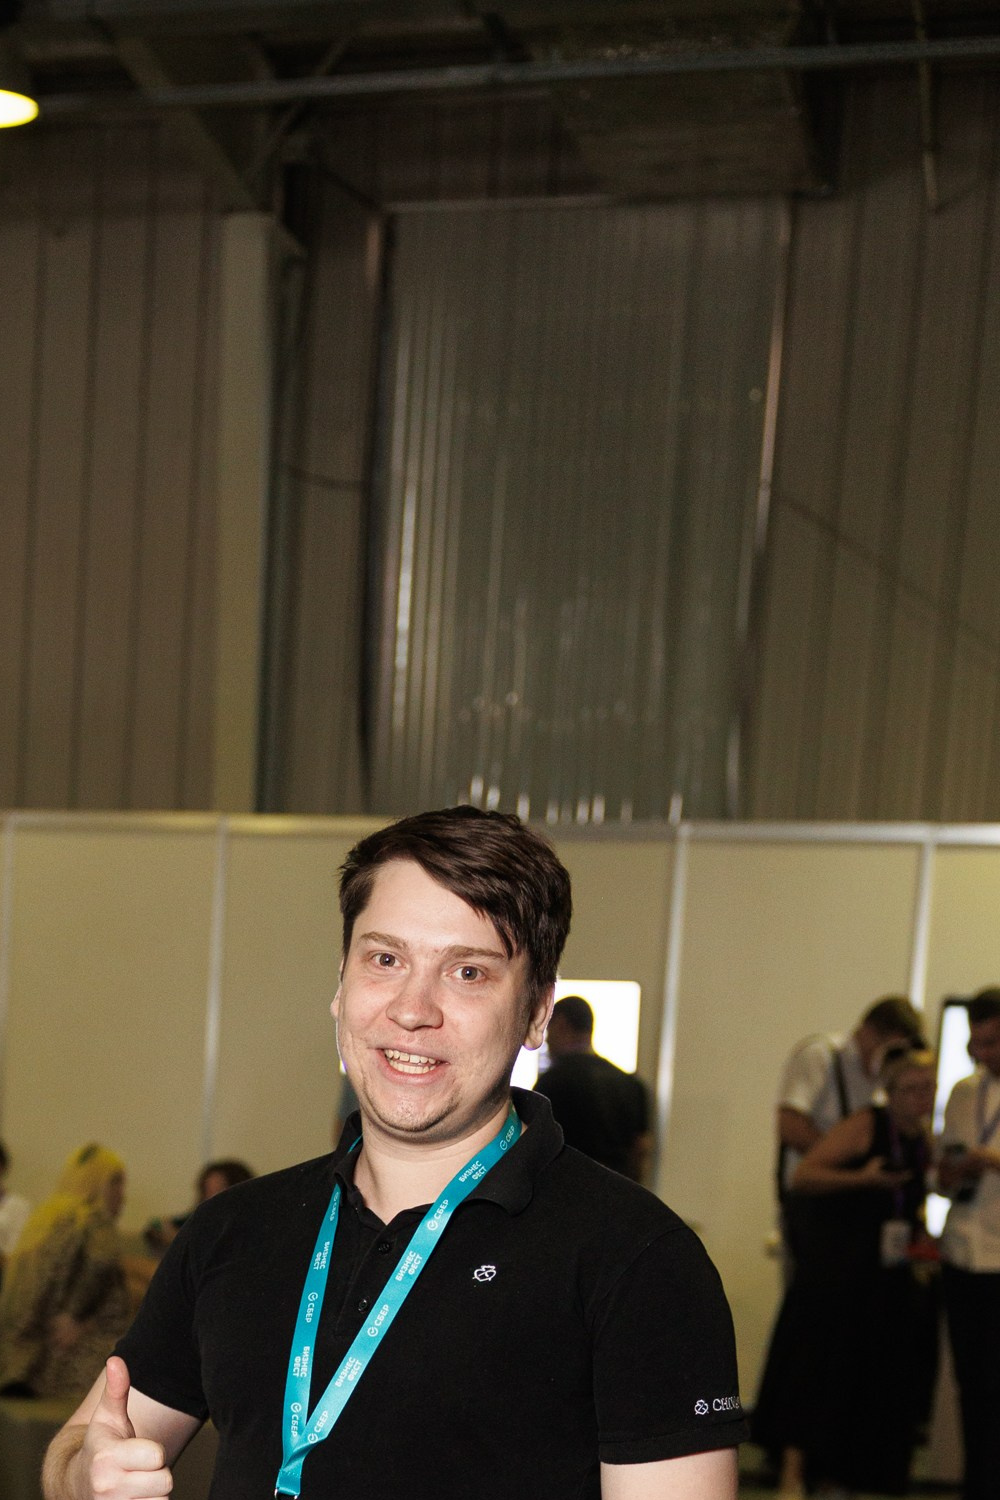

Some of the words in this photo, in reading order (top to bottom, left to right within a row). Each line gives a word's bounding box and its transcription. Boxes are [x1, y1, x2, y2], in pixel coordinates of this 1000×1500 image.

[458, 1160, 482, 1183] БИЗНЕС
[471, 1166, 487, 1180] ФЕСТ
[433, 1199, 449, 1219] СБЕР
[395, 1250, 417, 1282] БИЗНЕС
[407, 1254, 423, 1276] ФЕСТ
[305, 1302, 315, 1323] СБЕР
[374, 1303, 390, 1327] СБЕР
[292, 1355, 301, 1377] ФЕСТ
[300, 1346, 311, 1378] БИЗНЕС
[334, 1356, 356, 1388] БИЗНЕС
[347, 1359, 362, 1381] ФЕСТ
[290, 1414, 299, 1437] СБЕР
[314, 1410, 329, 1433] СБЕР
